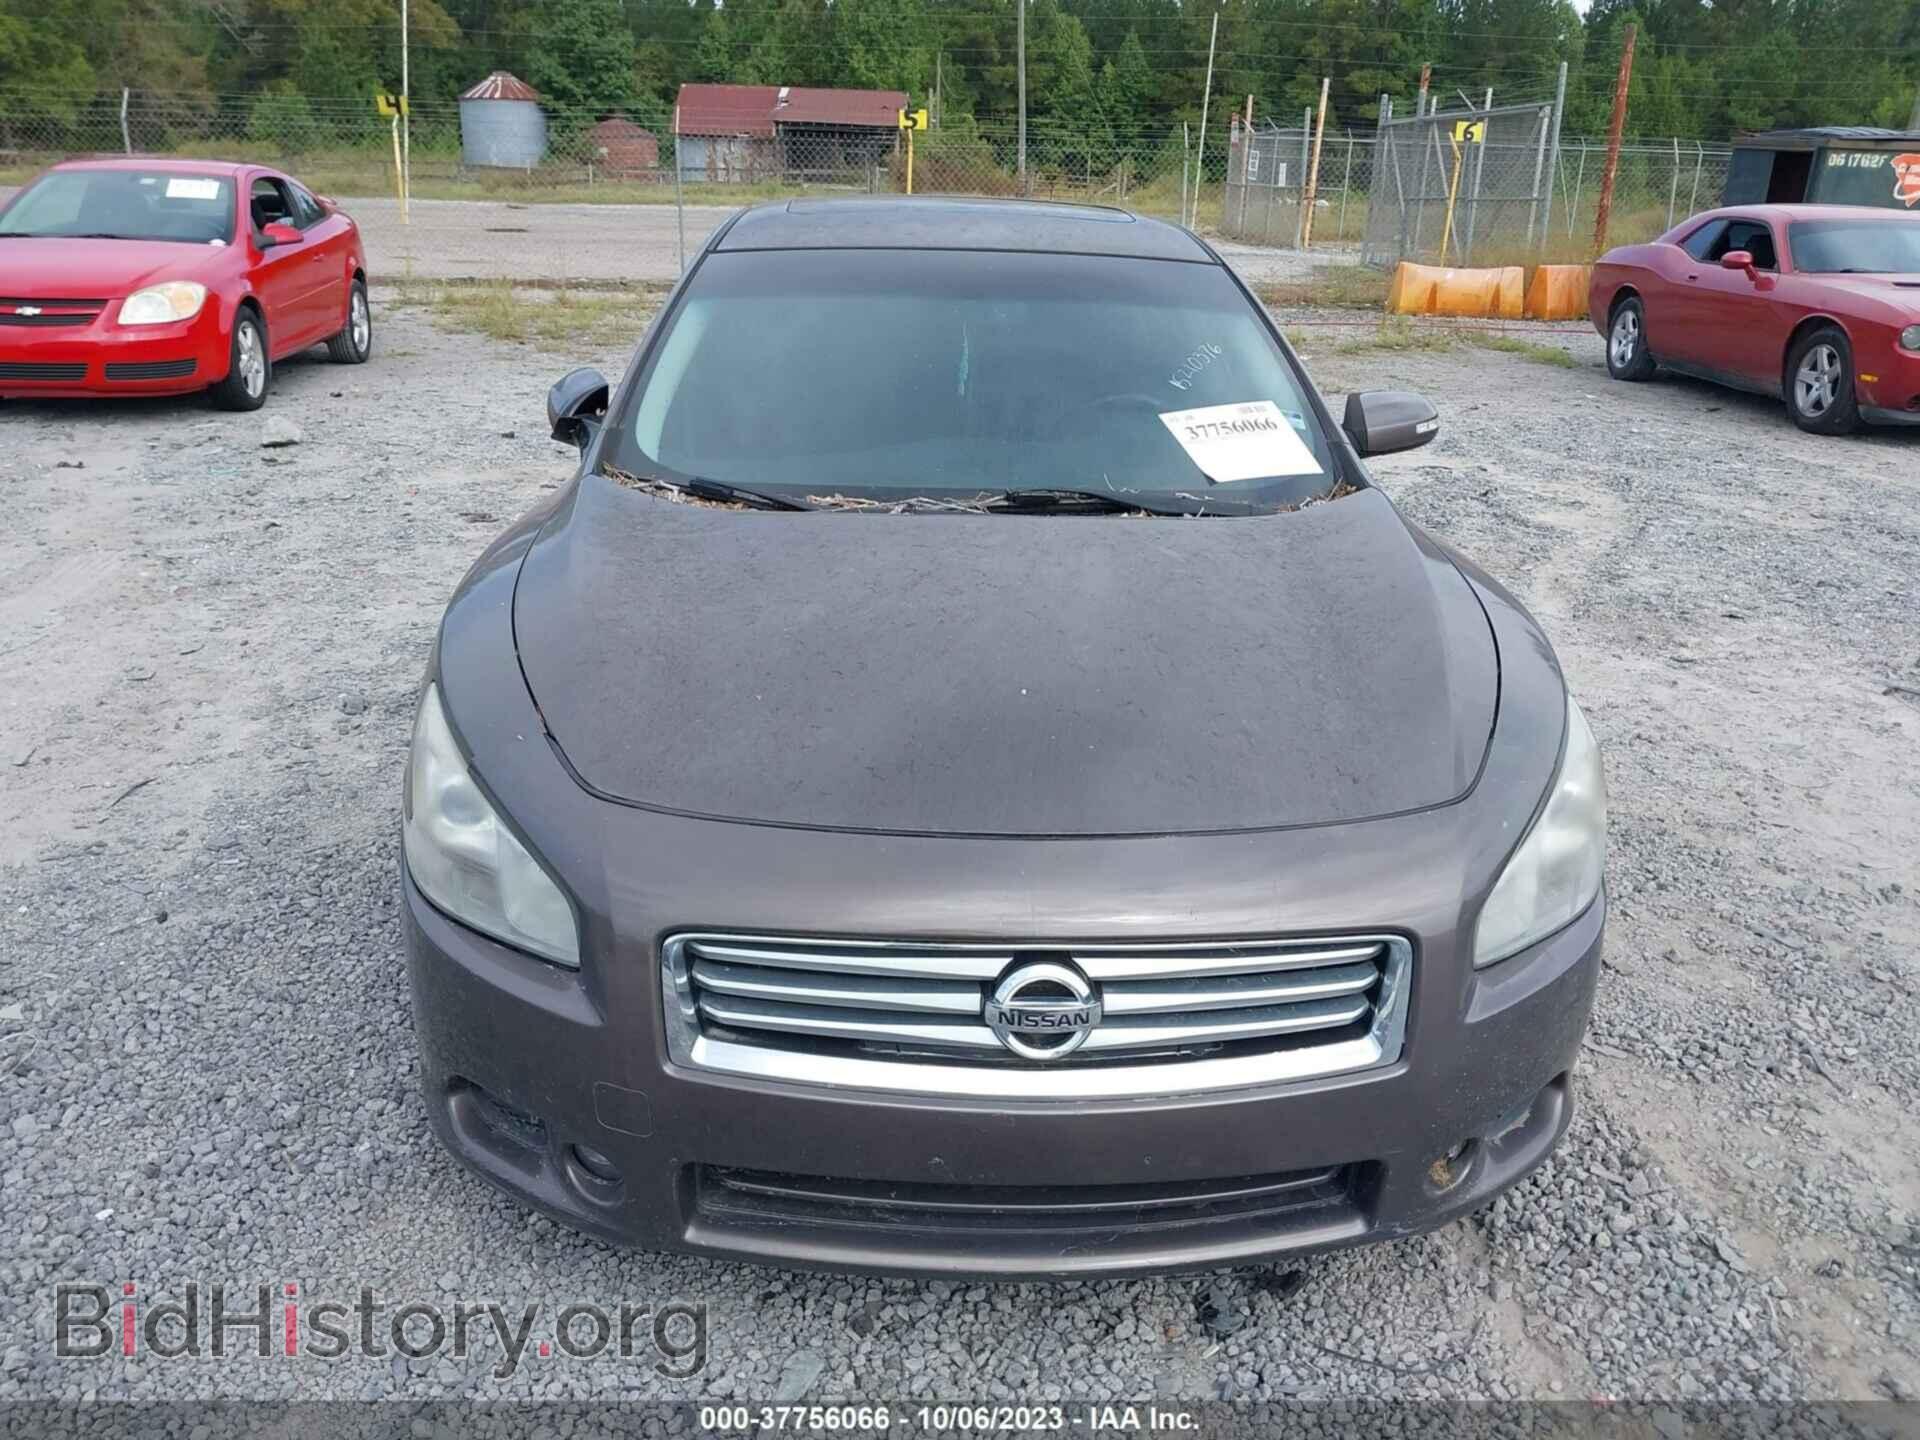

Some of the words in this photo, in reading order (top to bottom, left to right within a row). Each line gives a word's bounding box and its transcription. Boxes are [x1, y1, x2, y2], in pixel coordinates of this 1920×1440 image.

[385, 95, 402, 116] 4
[904, 109, 918, 129] 5
[1463, 121, 1478, 141] 6
[1184, 417, 1278, 440] 37756066
[998, 1010, 1090, 1028] NISSAN
